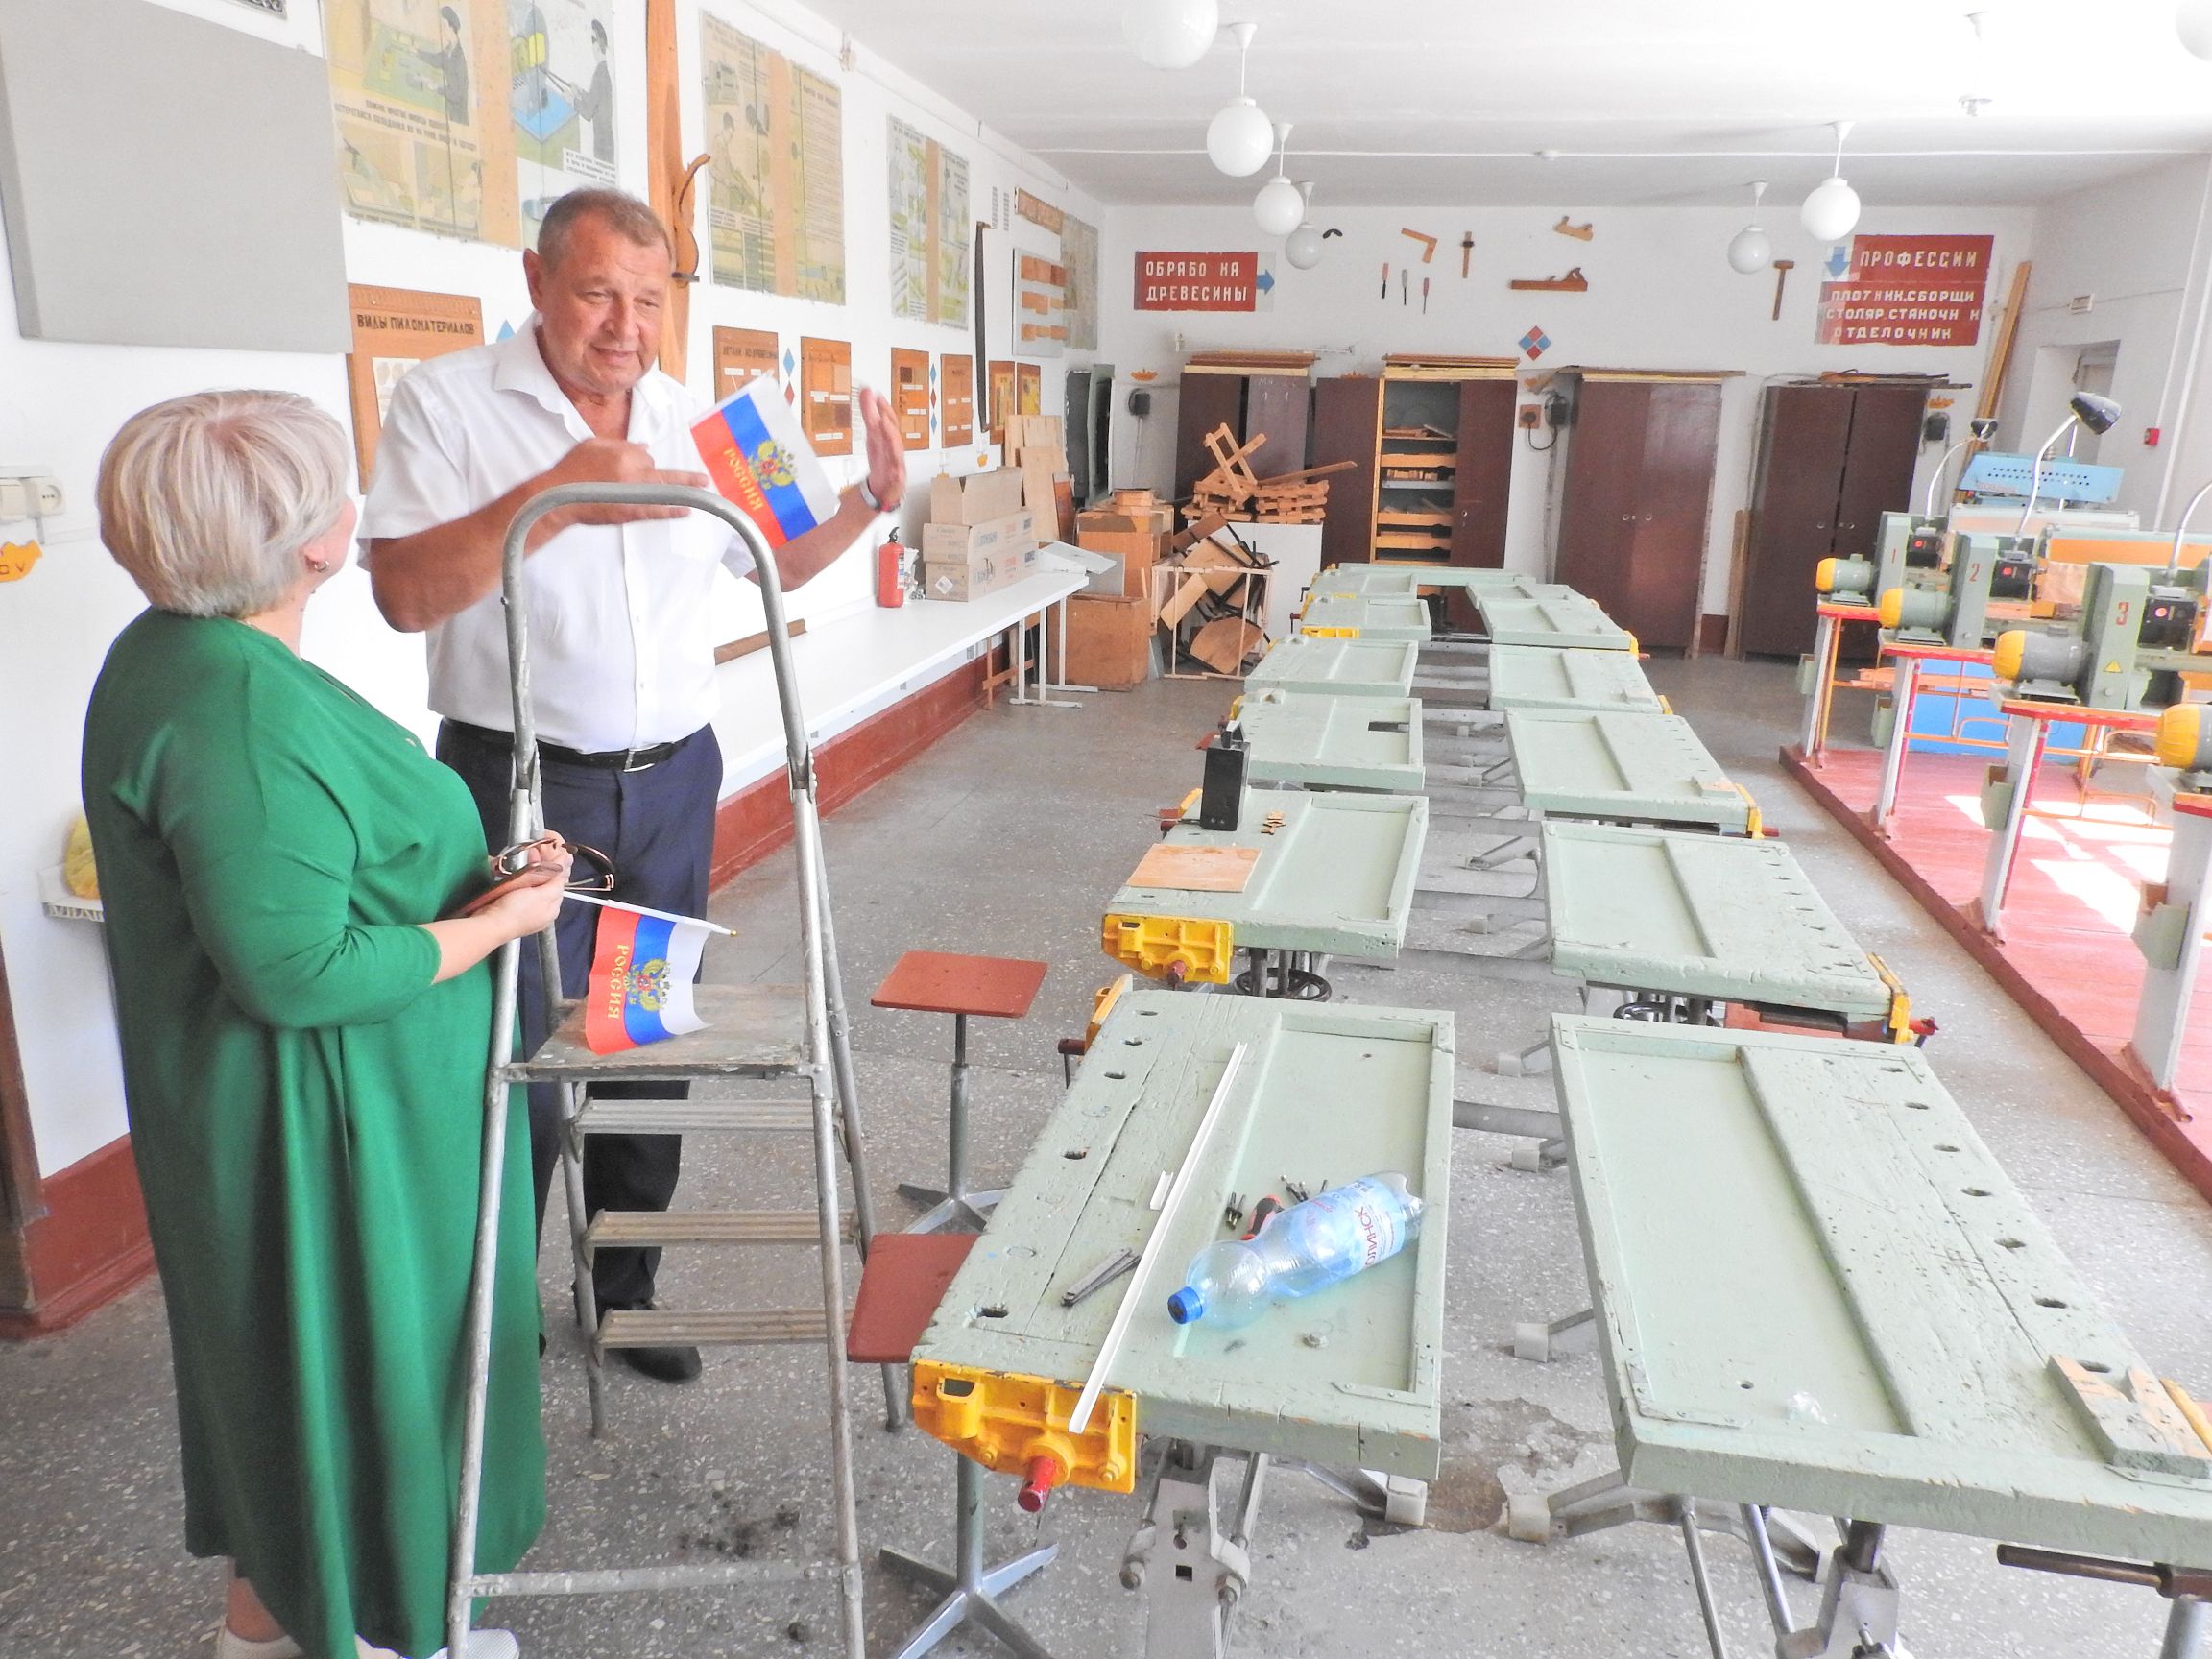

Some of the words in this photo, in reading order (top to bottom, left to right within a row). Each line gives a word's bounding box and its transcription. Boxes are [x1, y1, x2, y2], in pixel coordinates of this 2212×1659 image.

[1859, 250, 1978, 268] ПРОФЕССИИ
[1145, 285, 1248, 302] ДРЕВЕСИНЫ
[1826, 308, 1885, 320] СТОЛЯР
[356, 314, 388, 330] ВИДЫ
[390, 316, 476, 335] ПИЛОМАТЕРИАЛОВ
[723, 447, 764, 512] РОССИЯ
[1969, 563, 1981, 582] 2
[2115, 601, 2129, 626] 3
[607, 944, 630, 1020] РОССИЯ
